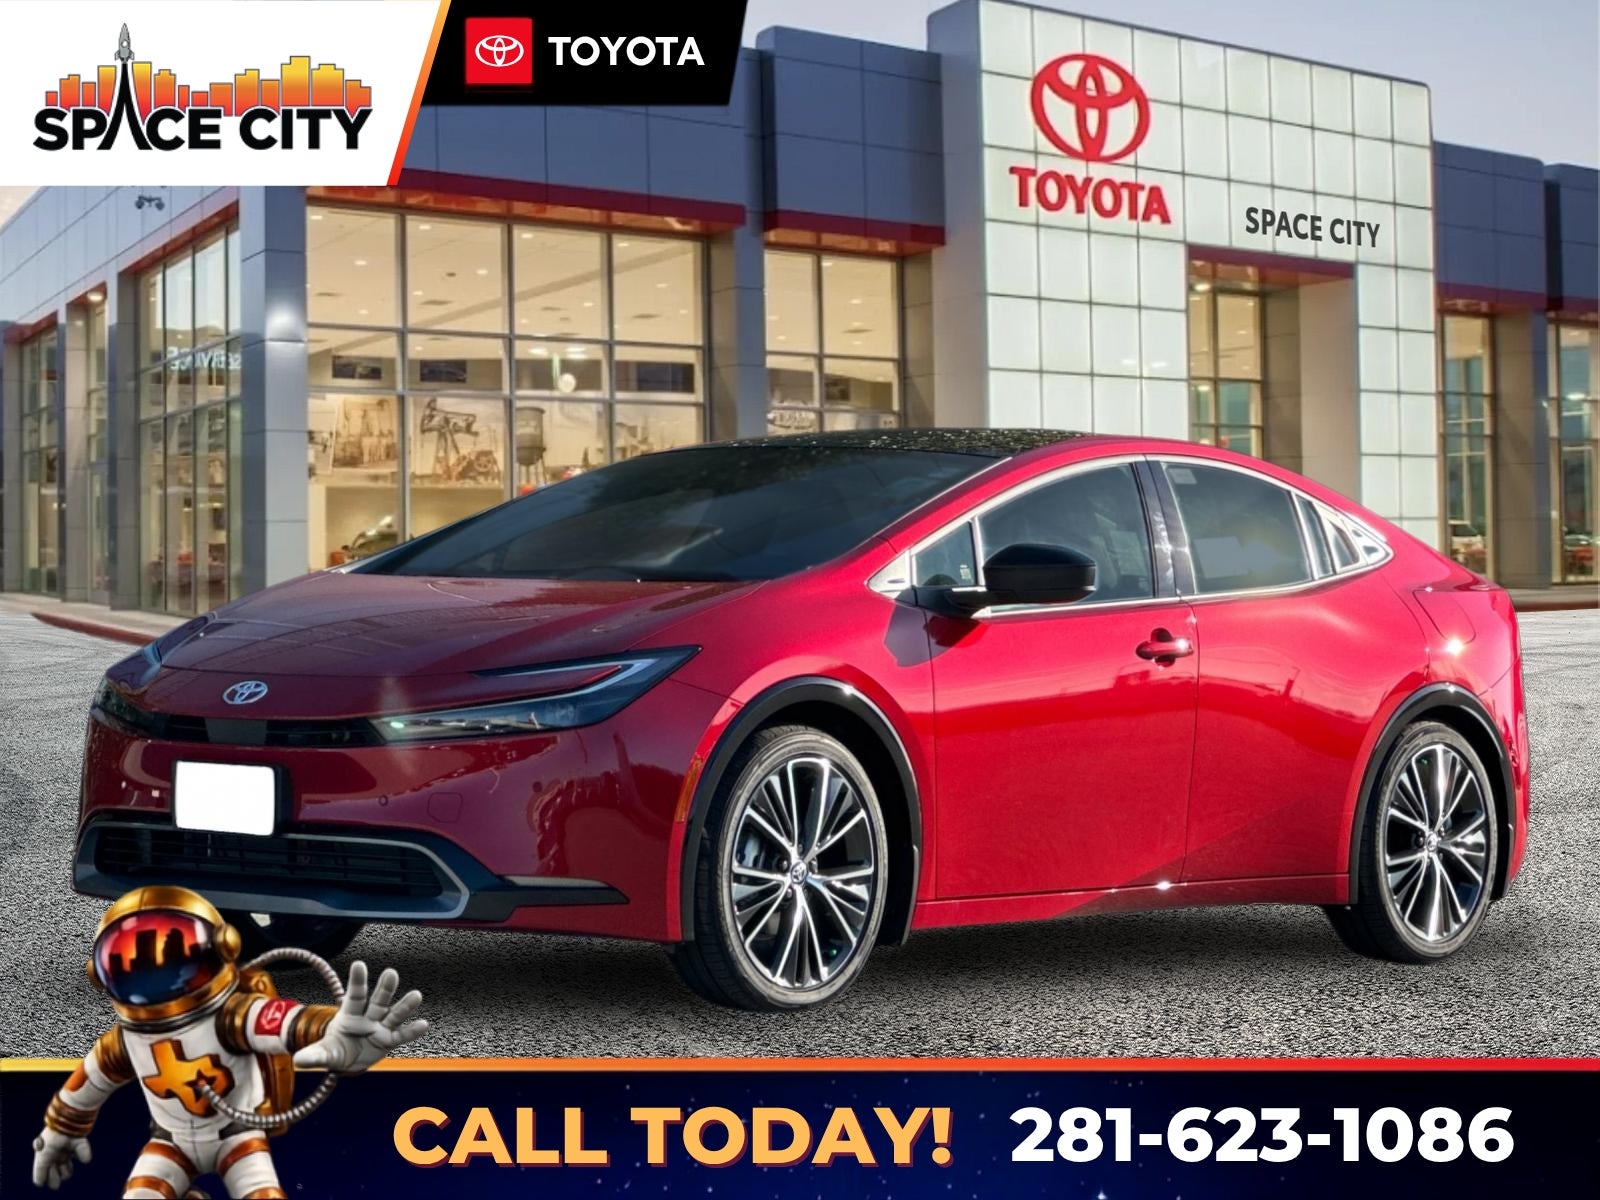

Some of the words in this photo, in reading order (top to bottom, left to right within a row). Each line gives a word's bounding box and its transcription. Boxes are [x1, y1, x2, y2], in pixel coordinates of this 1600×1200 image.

[1009, 167, 1170, 223] TOYOTA
[1245, 207, 1322, 241] SPACE
[1330, 218, 1380, 248] CITY
